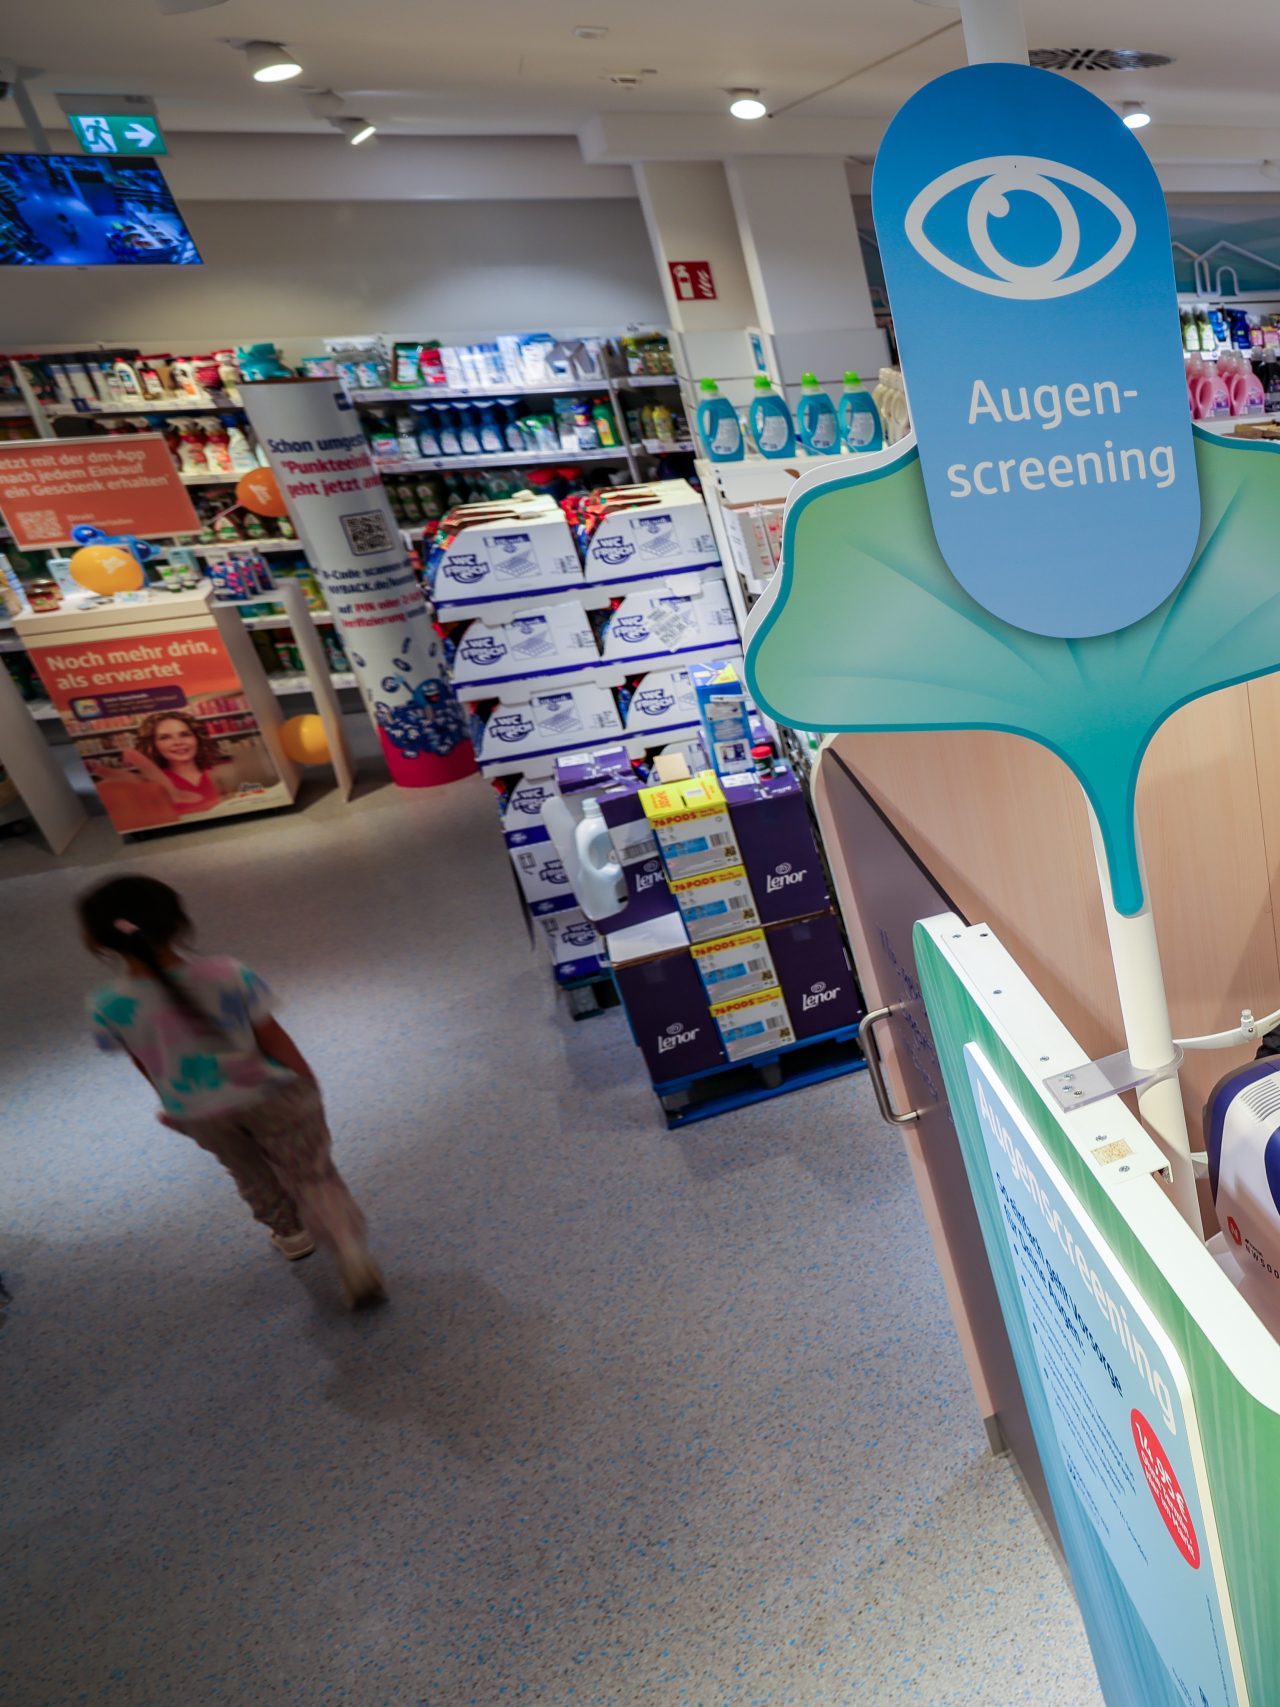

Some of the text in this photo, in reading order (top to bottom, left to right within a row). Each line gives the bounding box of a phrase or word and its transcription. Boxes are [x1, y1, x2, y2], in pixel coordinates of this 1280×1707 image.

[968, 379, 1138, 430] Augen-
[268, 437, 313, 453] Schon
[0, 449, 147, 469] etzt mit der dm-App
[947, 439, 1176, 498] screening
[39, 467, 86, 483] jedem
[89, 464, 144, 478] Einkauf
[5, 486, 30, 498] ein
[32, 479, 104, 496] Geschenk
[321, 478, 360, 497] jetzt
[46, 639, 218, 671] Noch mehr drin,
[56, 661, 184, 690] als erwartet
[766, 869, 807, 892] Lenor
[802, 986, 841, 1011] Lenor
[658, 1027, 700, 1053] Lenor
[977, 1078, 1177, 1436] Augenscreening
[1069, 1295, 1124, 1398] Vorsorge
